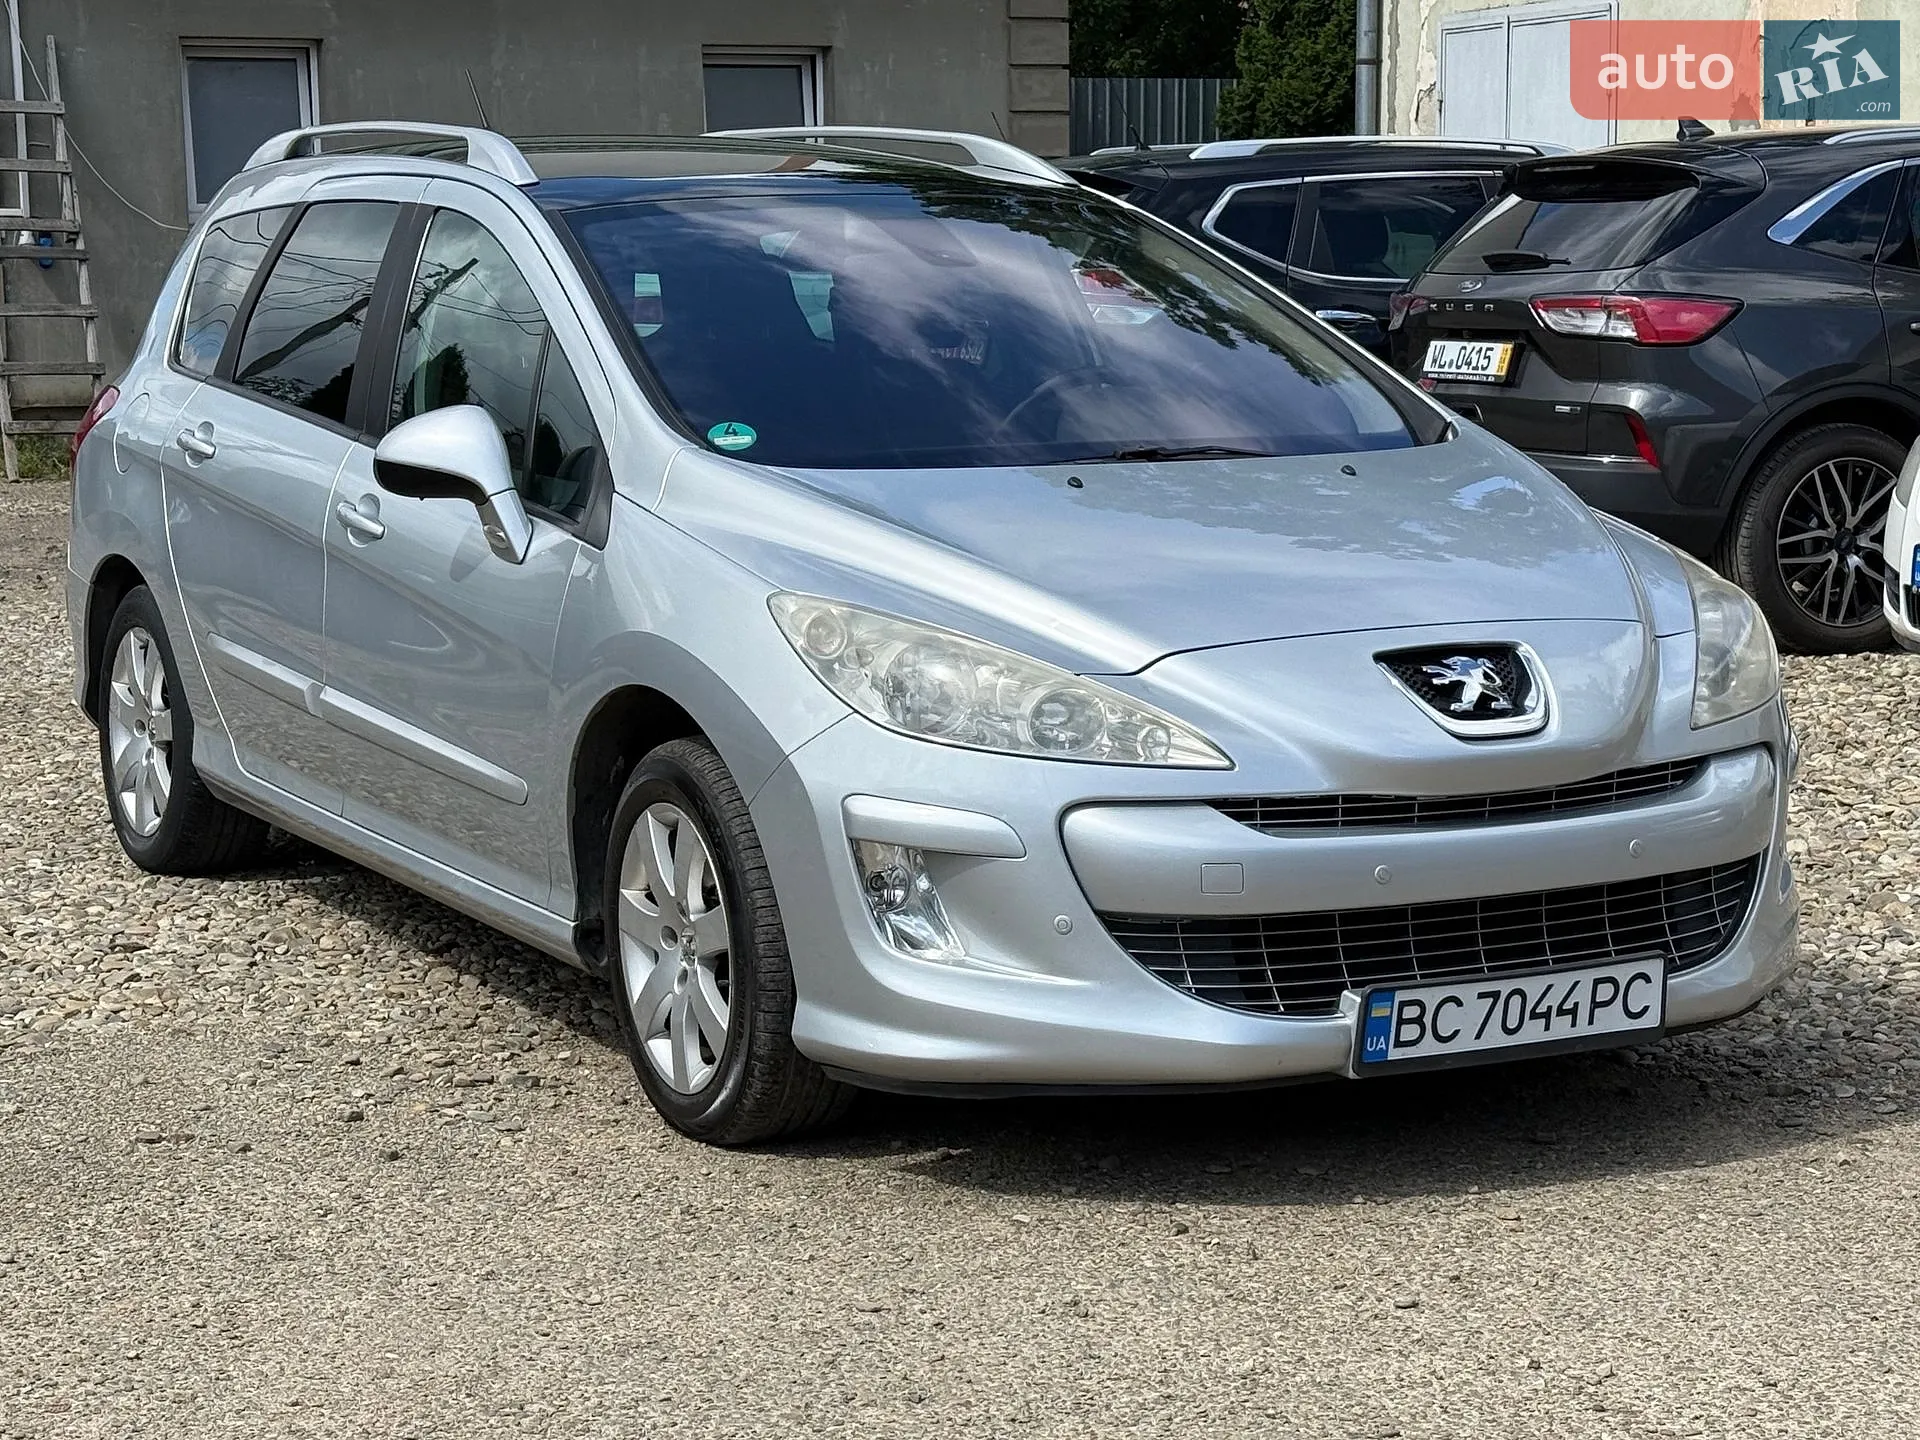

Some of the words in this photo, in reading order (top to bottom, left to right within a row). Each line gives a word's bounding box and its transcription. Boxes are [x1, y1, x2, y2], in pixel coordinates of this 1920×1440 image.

[1455, 345, 1495, 372] 0415
[1392, 995, 1464, 1050] BC
[1473, 979, 1582, 1041] 7044
[1587, 971, 1653, 1027] PC
[1367, 1036, 1387, 1052] UA
